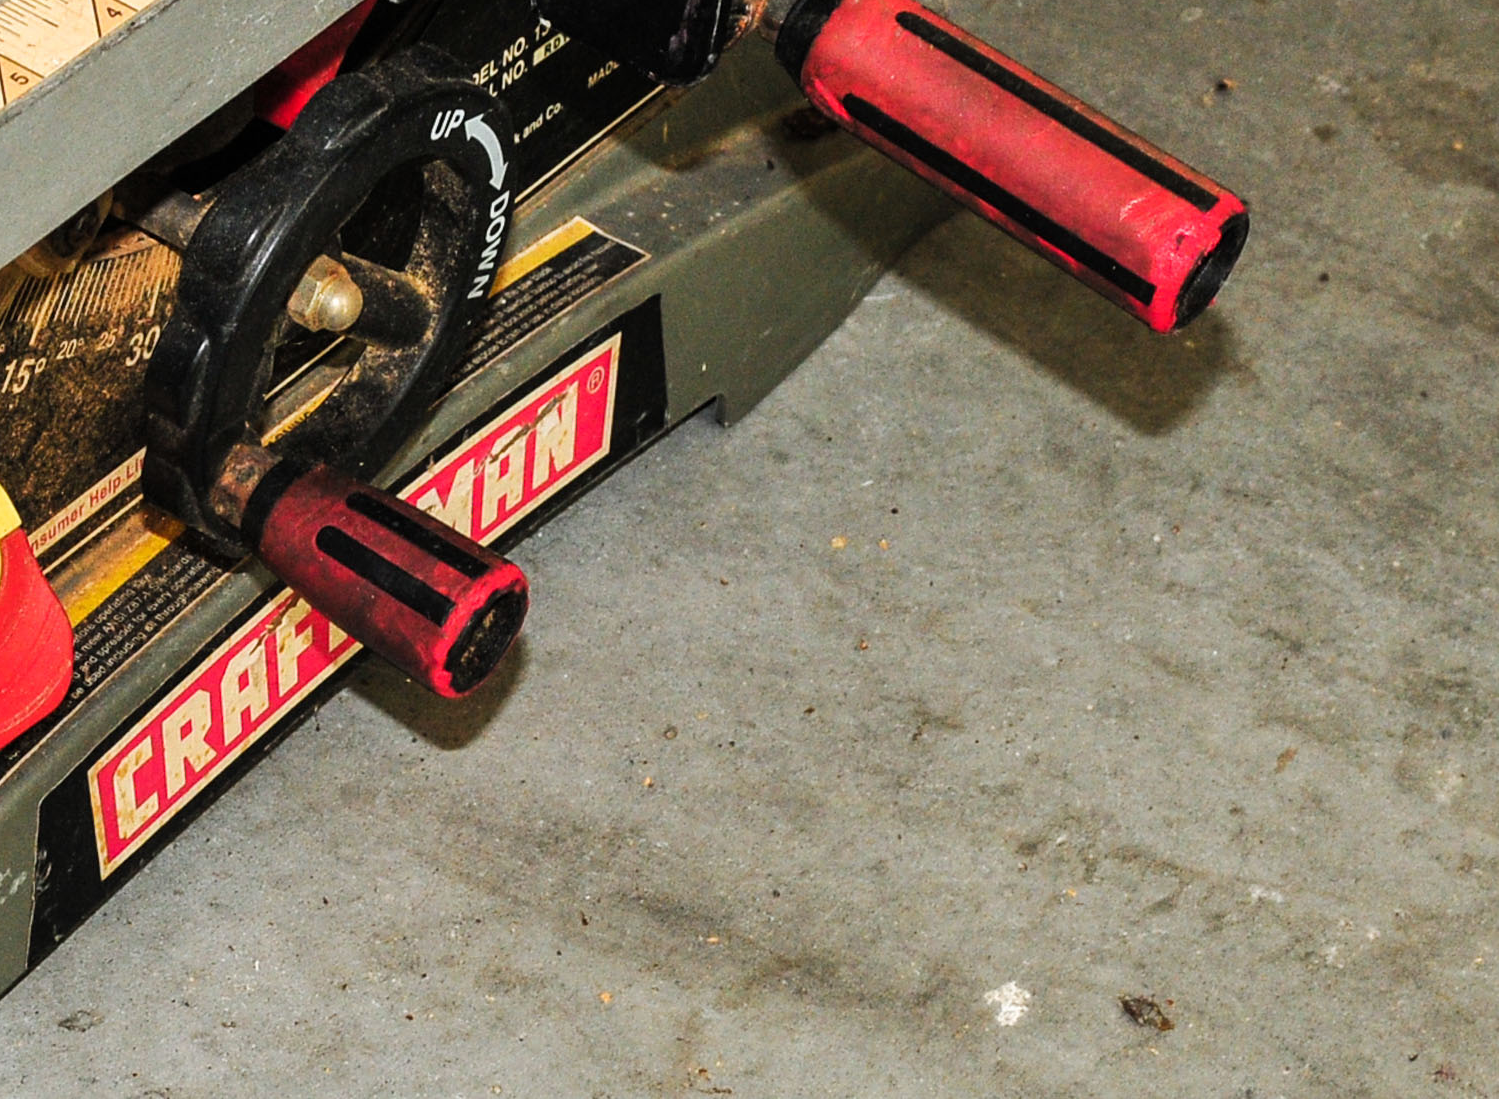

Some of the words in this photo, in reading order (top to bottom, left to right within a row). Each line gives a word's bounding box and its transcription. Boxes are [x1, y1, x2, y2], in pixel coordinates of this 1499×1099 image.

[9, 72, 31, 87] 5
[106, 5, 123, 20] 4
[472, 60, 499, 86] DEL
[502, 36, 529, 68] NO.
[502, 59, 528, 91] NO.
[430, 108, 466, 141] UP
[522, 115, 544, 140] and
[545, 101, 564, 122] Co.
[466, 189, 511, 300] DOWN
[31, 502, 85, 551] nsumer
[89, 475, 121, 509] Help
[111, 379, 580, 842] CRAFMAN
